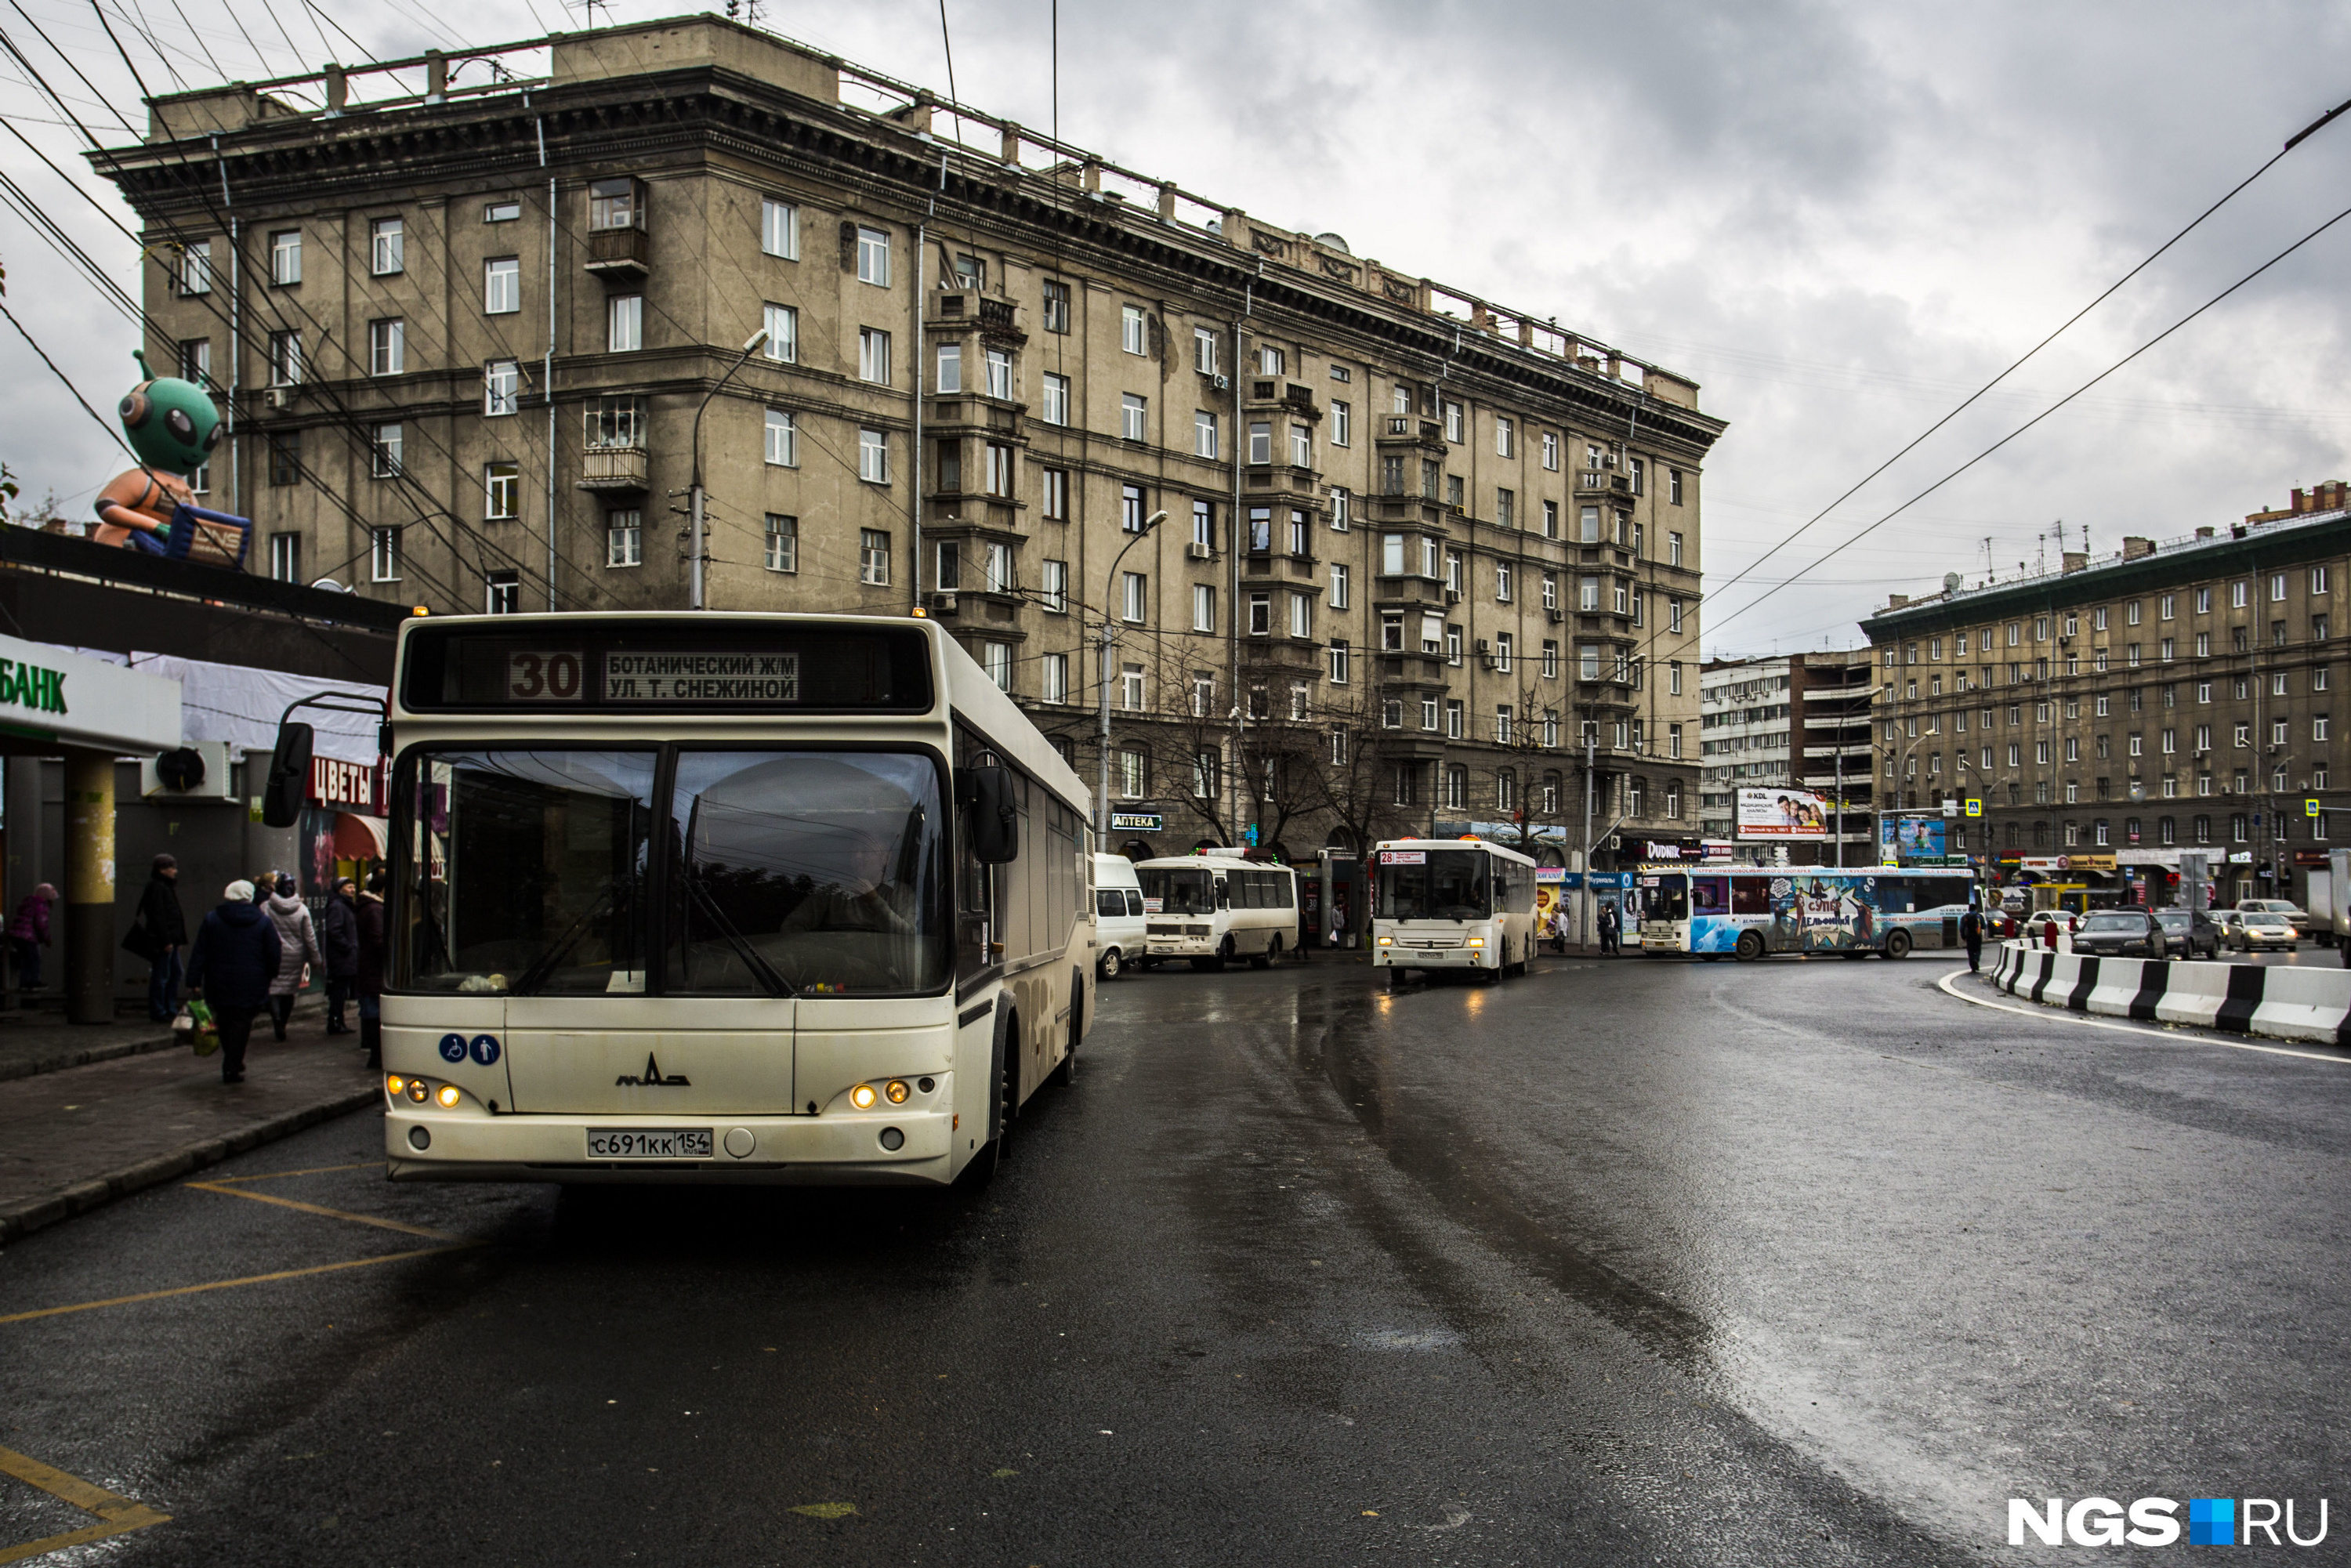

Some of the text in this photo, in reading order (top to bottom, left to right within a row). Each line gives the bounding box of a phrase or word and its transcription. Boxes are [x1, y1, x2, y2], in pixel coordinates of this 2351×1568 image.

[195, 526, 241, 549] DNS
[609, 654, 795, 675] БОТАНИЧЕСКИЙ Ж/М
[511, 653, 581, 698] 30
[609, 675, 795, 699] УЛ. Т. СНЕЖИНОЙ
[313, 757, 371, 807] ЦВЕТЫ
[1114, 816, 1154, 827] АПТЕКА
[1381, 853, 1393, 864] 28
[1646, 840, 1680, 859] DUDNIK
[1808, 900, 1842, 912] СУПЕР
[595, 1133, 707, 1154] С691КК 154
